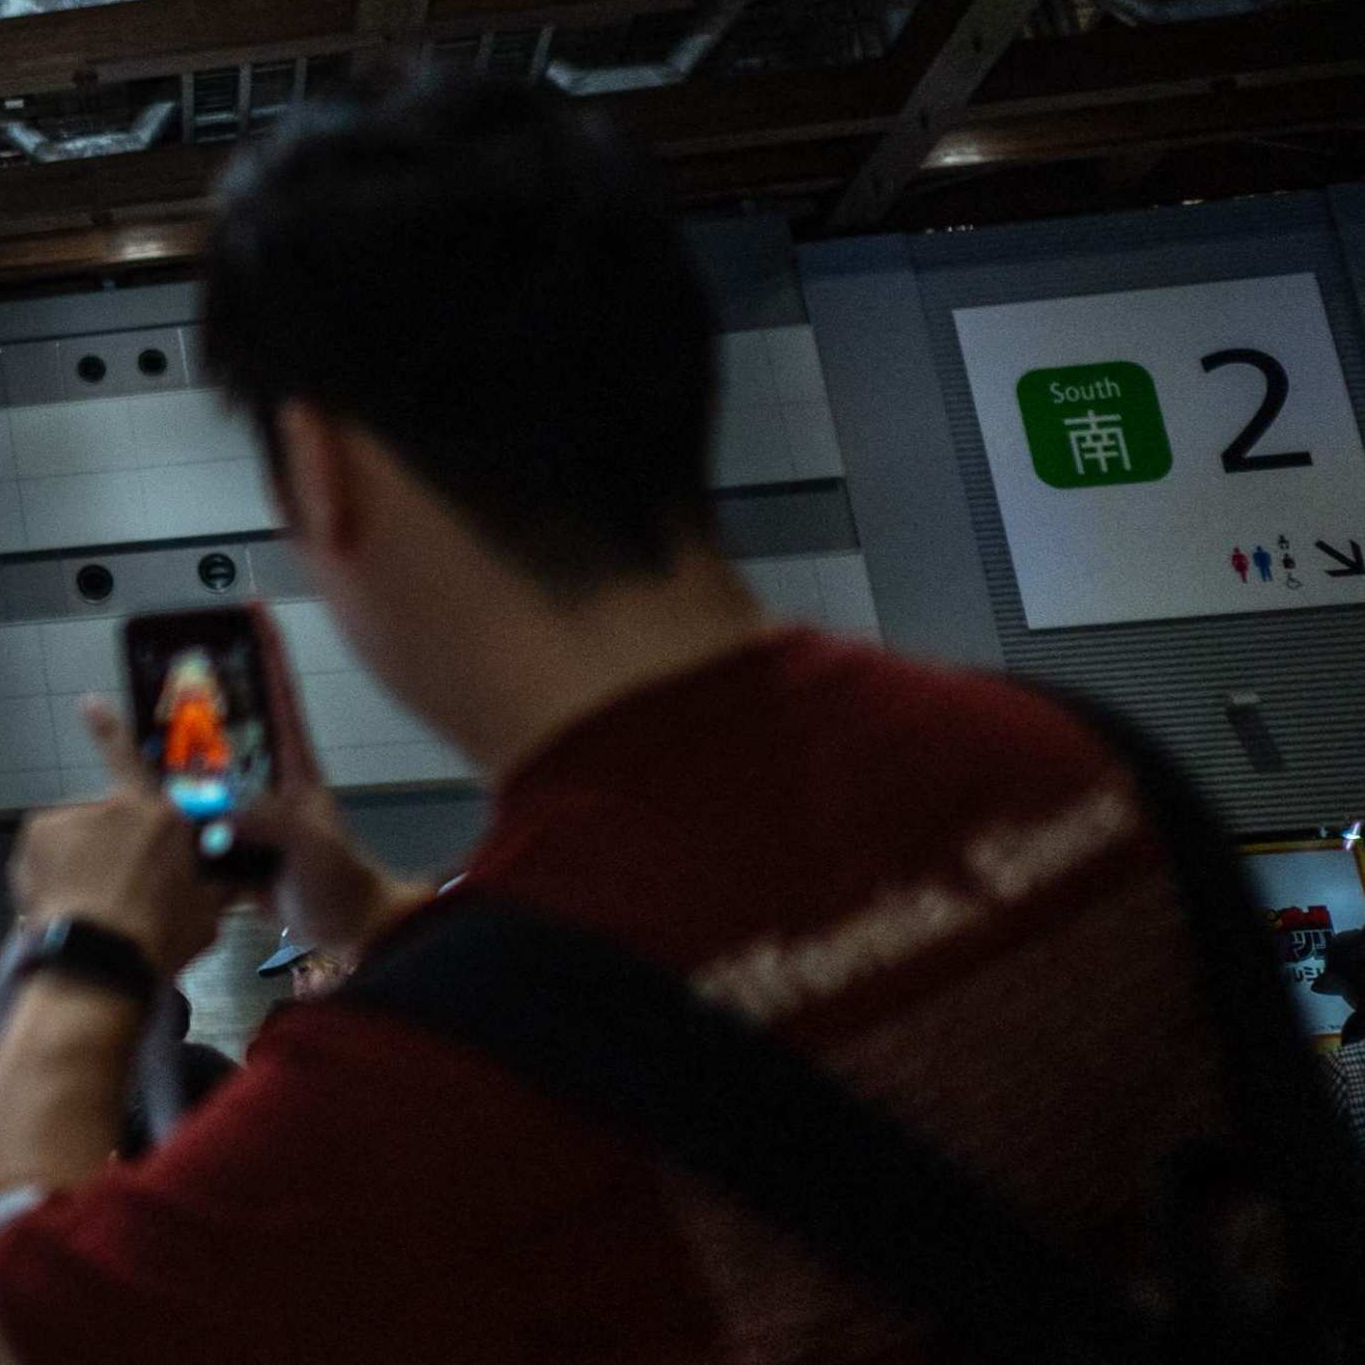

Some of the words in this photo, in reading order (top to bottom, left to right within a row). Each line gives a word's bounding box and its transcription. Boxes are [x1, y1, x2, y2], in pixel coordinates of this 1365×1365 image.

[1050, 378, 1121, 404] South
[1201, 348, 1313, 473] 2
[1063, 409, 1132, 475] 南
